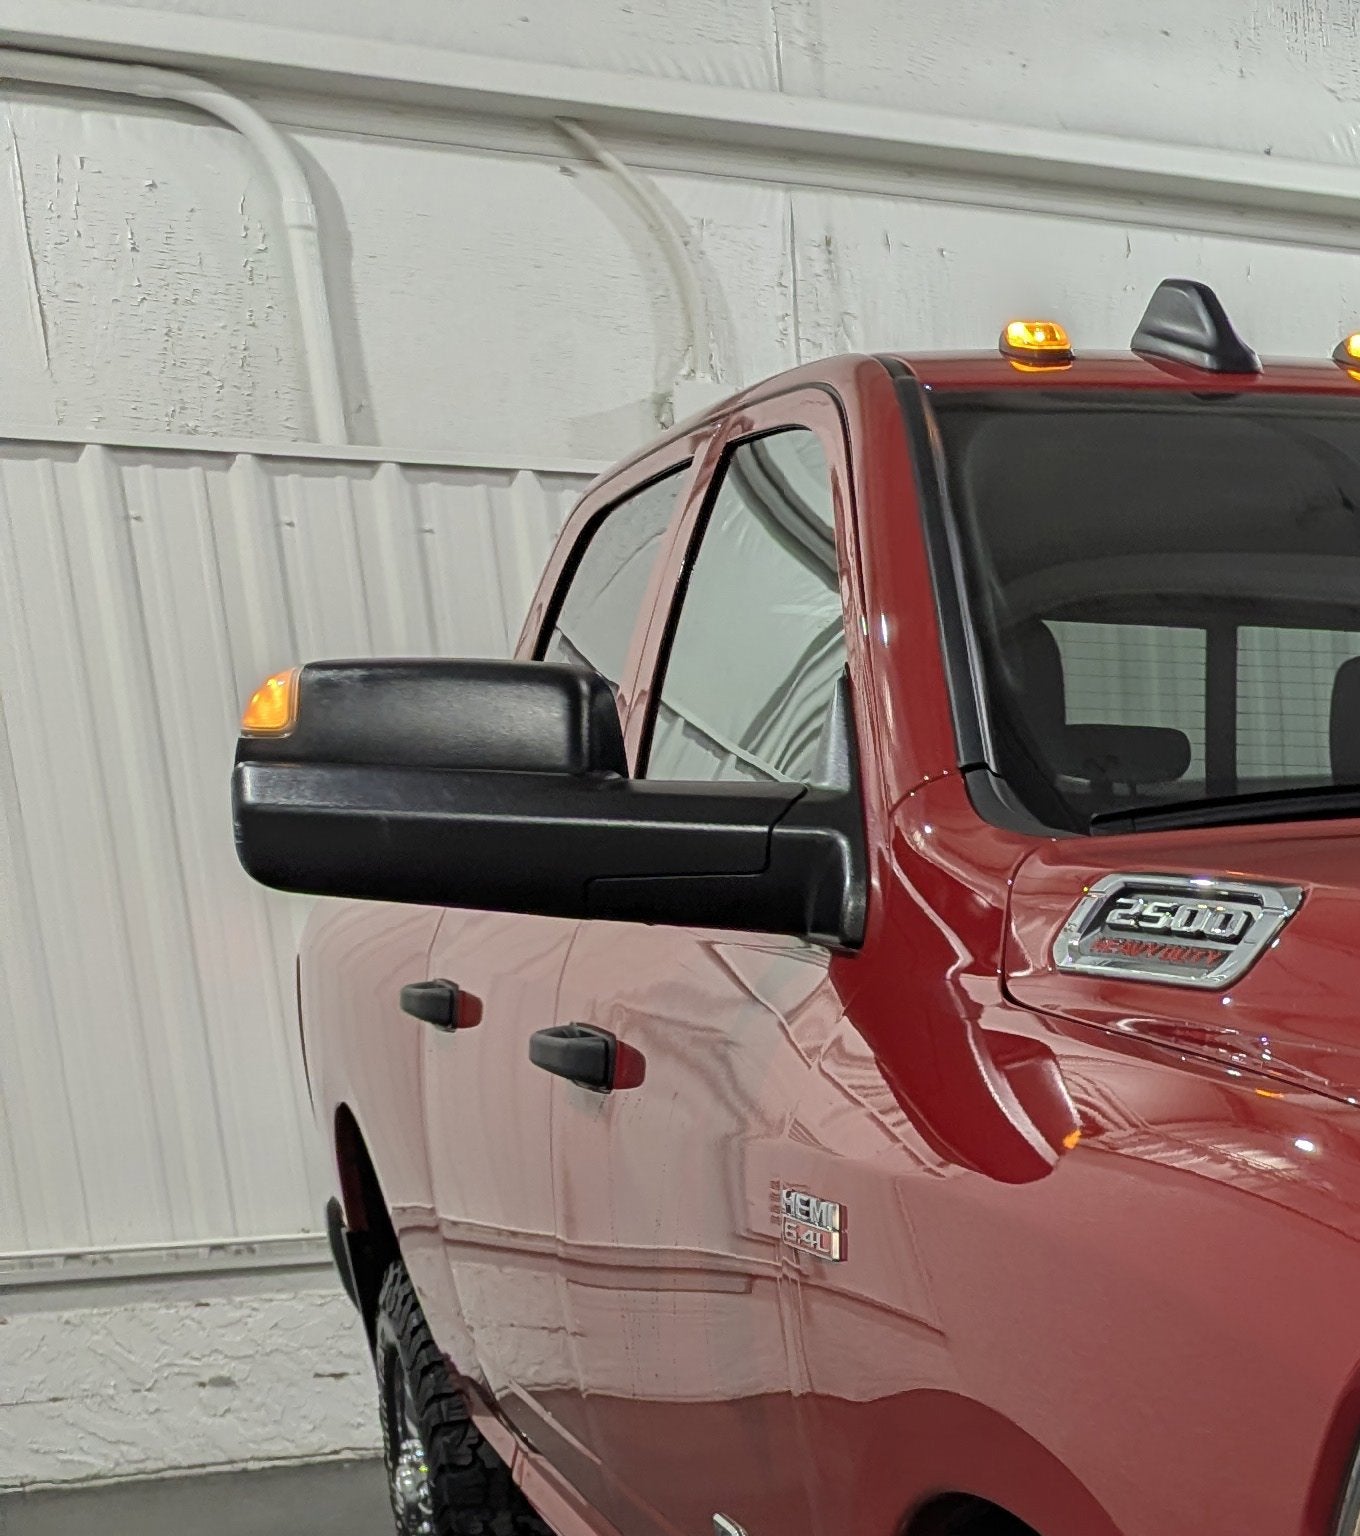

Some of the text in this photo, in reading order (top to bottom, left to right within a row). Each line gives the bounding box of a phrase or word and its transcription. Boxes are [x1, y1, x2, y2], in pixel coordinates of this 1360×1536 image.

[1105, 897, 1251, 940] 2500
[1090, 937, 1224, 966] HEAVY DUTY
[782, 1189, 841, 1231] HEMI
[784, 1222, 831, 1252] 6.4L
